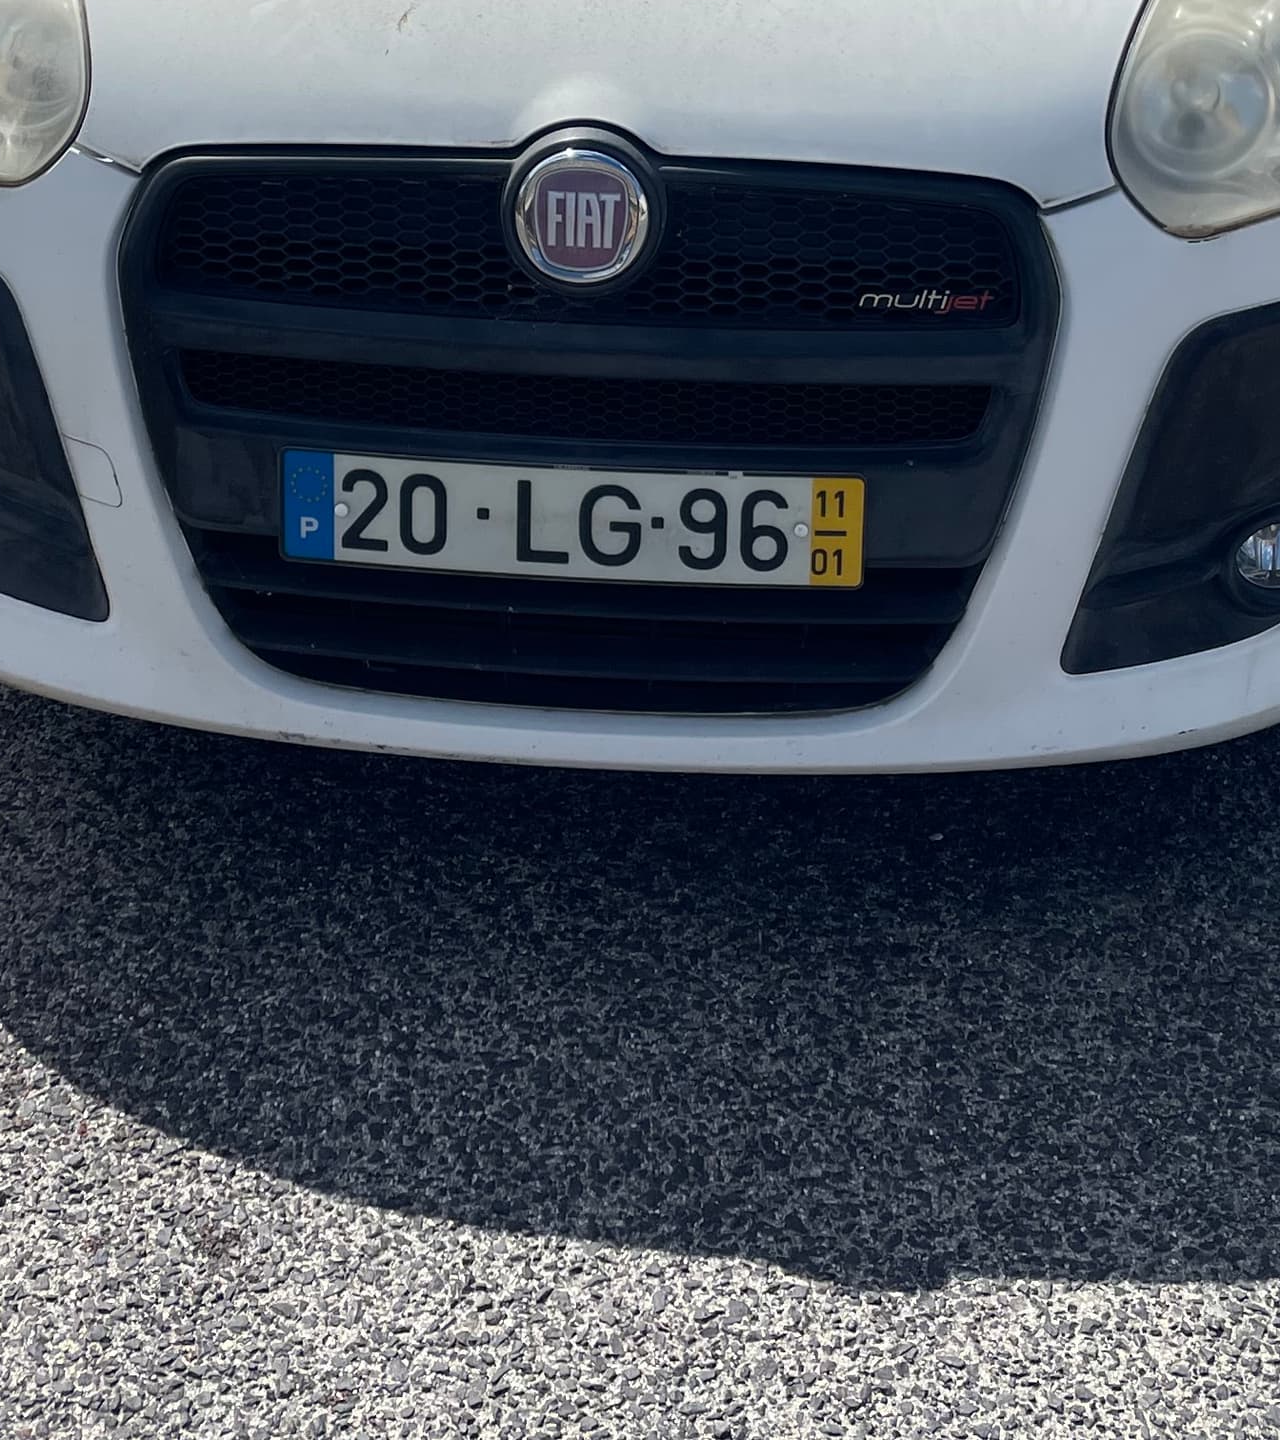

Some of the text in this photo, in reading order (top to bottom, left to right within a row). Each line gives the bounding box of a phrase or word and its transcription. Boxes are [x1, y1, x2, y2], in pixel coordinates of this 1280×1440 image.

[546, 190, 622, 250] FIAT
[858, 289, 995, 315] multijet
[815, 489, 845, 519] 11
[299, 516, 320, 540] P
[810, 548, 843, 577] 01
